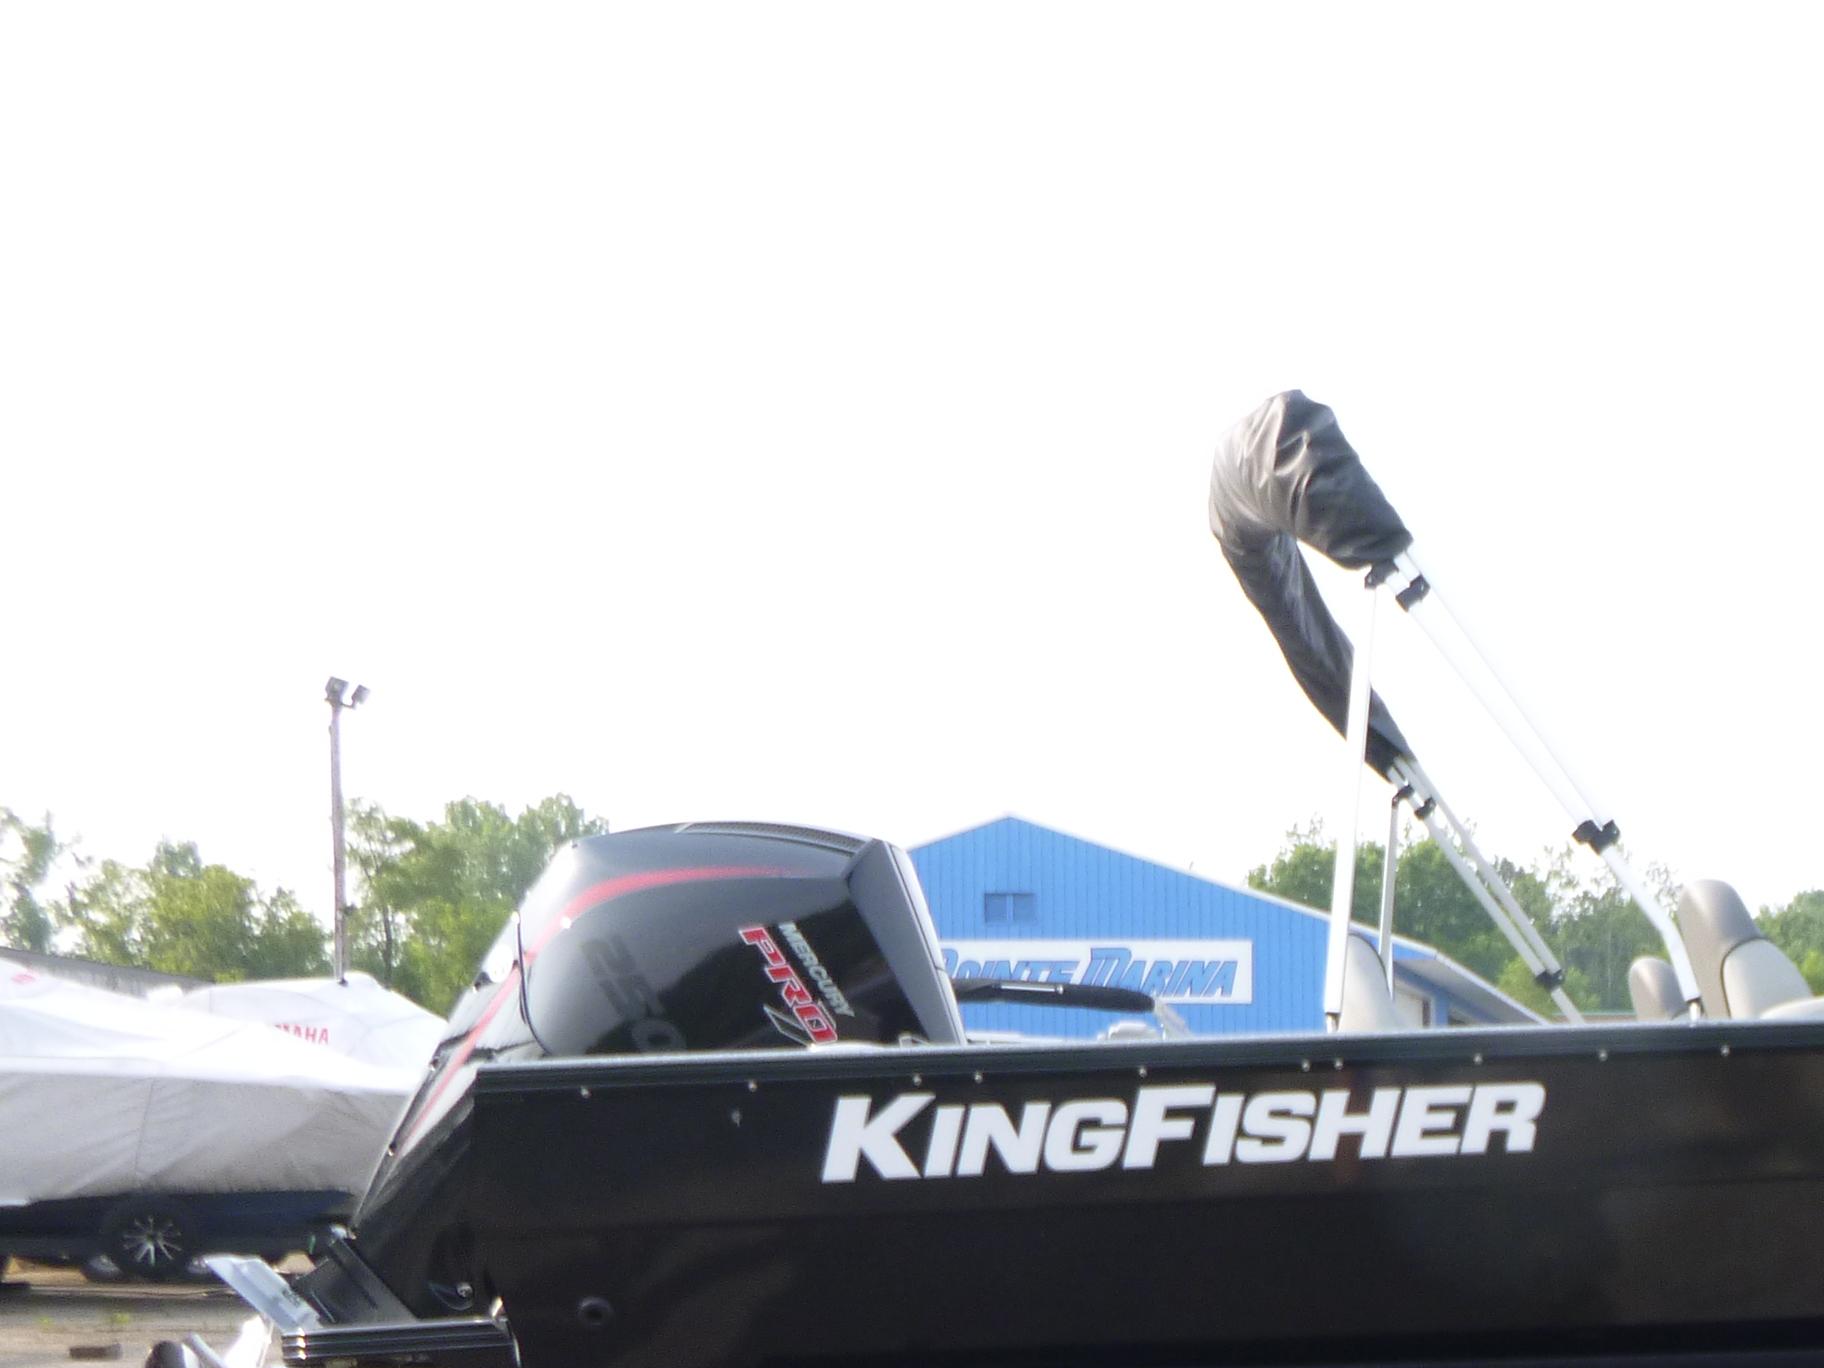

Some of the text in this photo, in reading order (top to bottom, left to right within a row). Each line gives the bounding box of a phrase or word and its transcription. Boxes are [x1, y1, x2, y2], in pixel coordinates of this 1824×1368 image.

[739, 927, 838, 1044] PRO
[779, 922, 855, 1017] MERCURY
[1081, 948, 1238, 998] MARINA
[821, 1083, 1546, 1183] KINGFISHER
